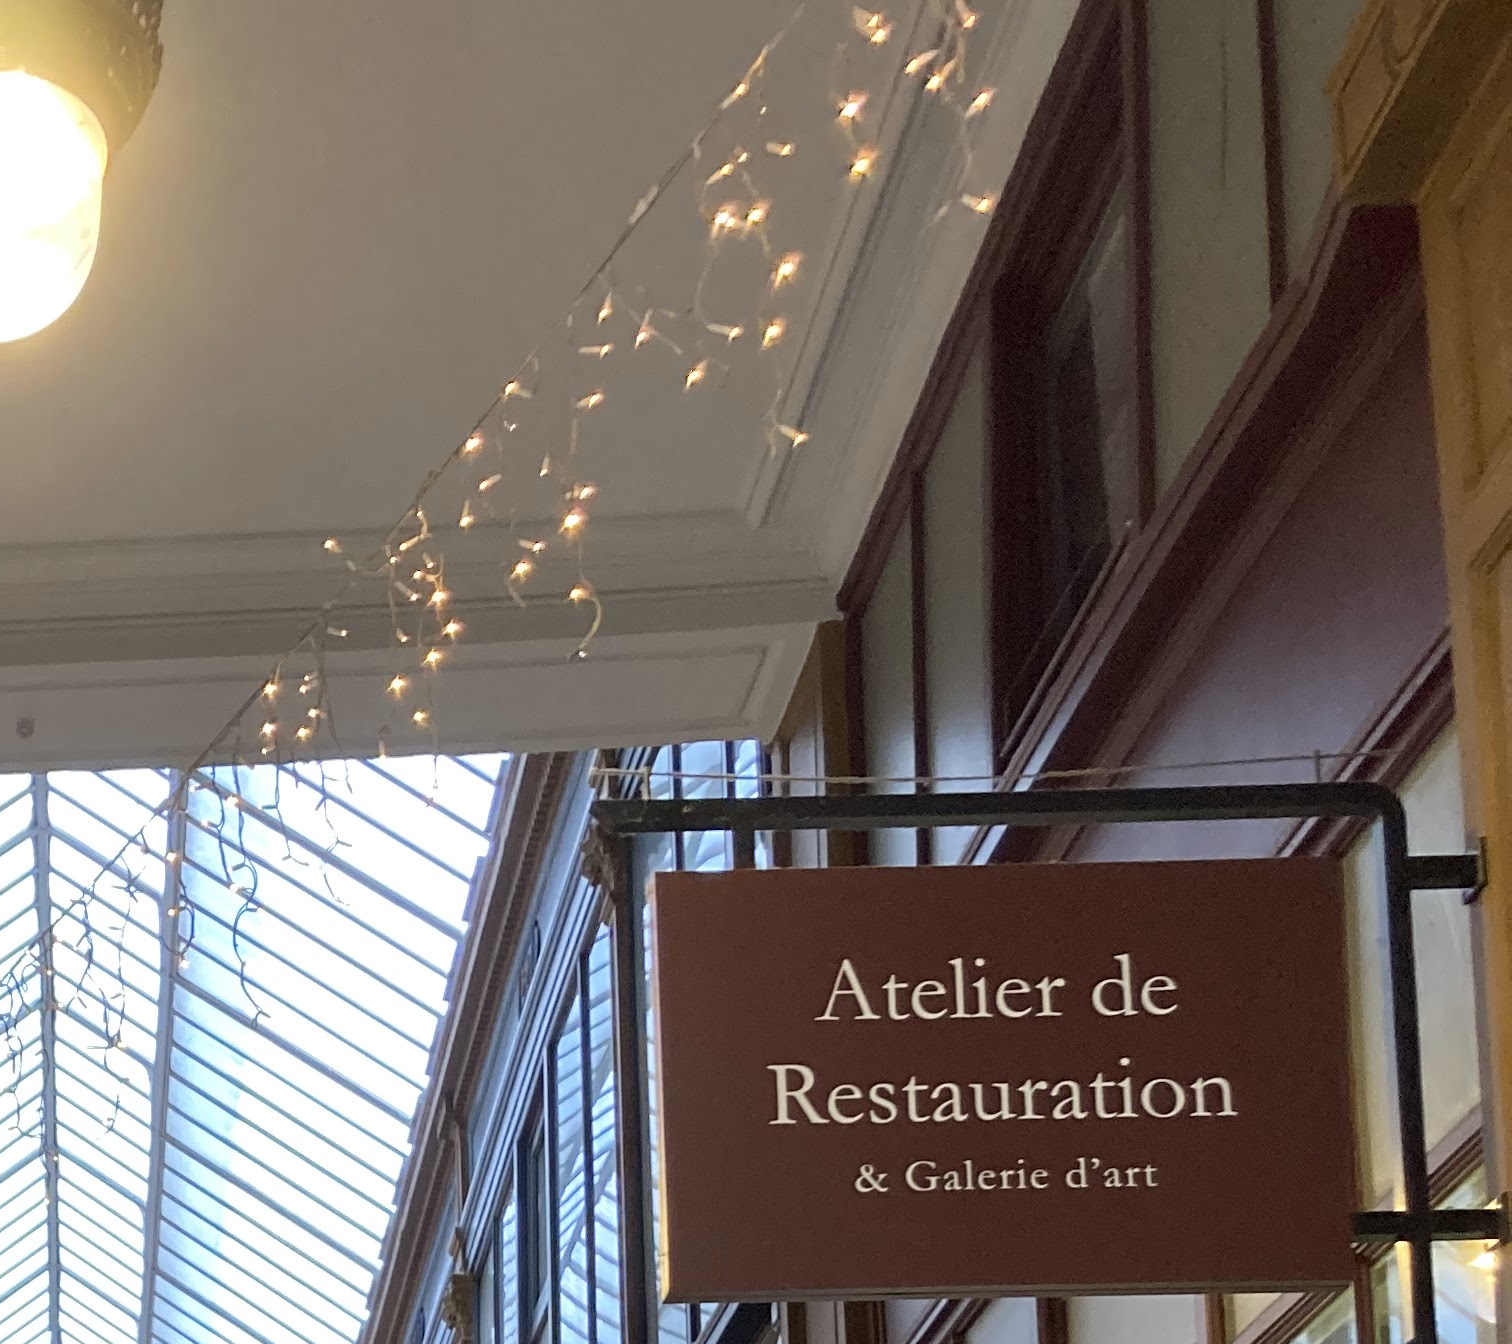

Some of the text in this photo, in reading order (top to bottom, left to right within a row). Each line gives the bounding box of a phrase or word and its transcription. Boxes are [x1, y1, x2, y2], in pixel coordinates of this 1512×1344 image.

[814, 953, 1179, 1022] Atelier de
[767, 1058, 1238, 1127] Restauration
[855, 1157, 1159, 1195] & Galerie d'art
